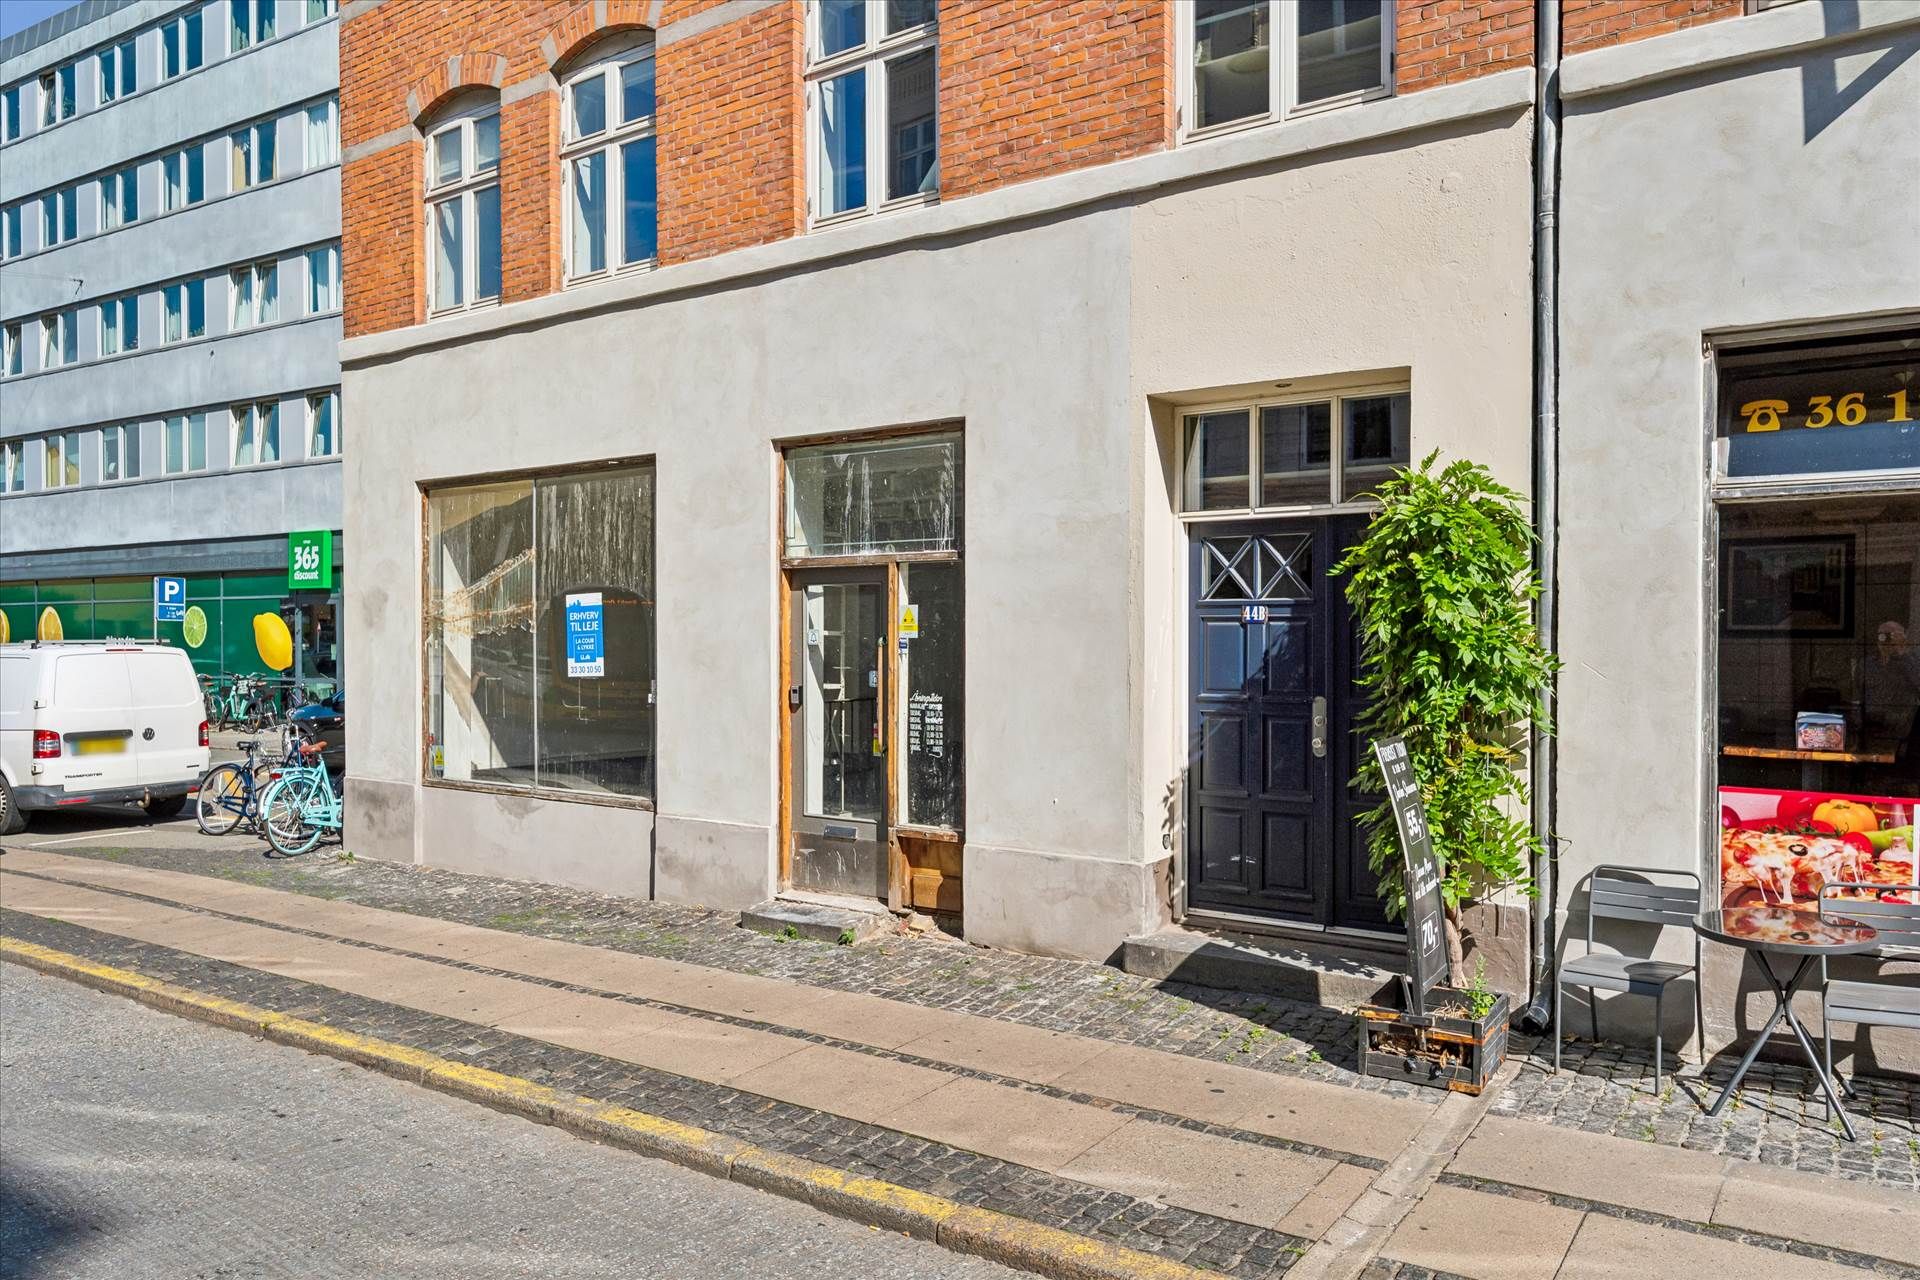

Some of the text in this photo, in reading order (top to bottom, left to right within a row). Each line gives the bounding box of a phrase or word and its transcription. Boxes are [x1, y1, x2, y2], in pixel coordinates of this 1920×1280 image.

[1805, 393, 1866, 428] 36
[294, 546, 319, 570] 365
[294, 571, 319, 580] discount
[164, 581, 180, 602] P
[570, 611, 599, 621] ERHVERV
[1242, 606, 1265, 620] 44B
[570, 621, 599, 632] TIL LEJE
[570, 666, 578, 674] 33
[579, 666, 586, 674] 30
